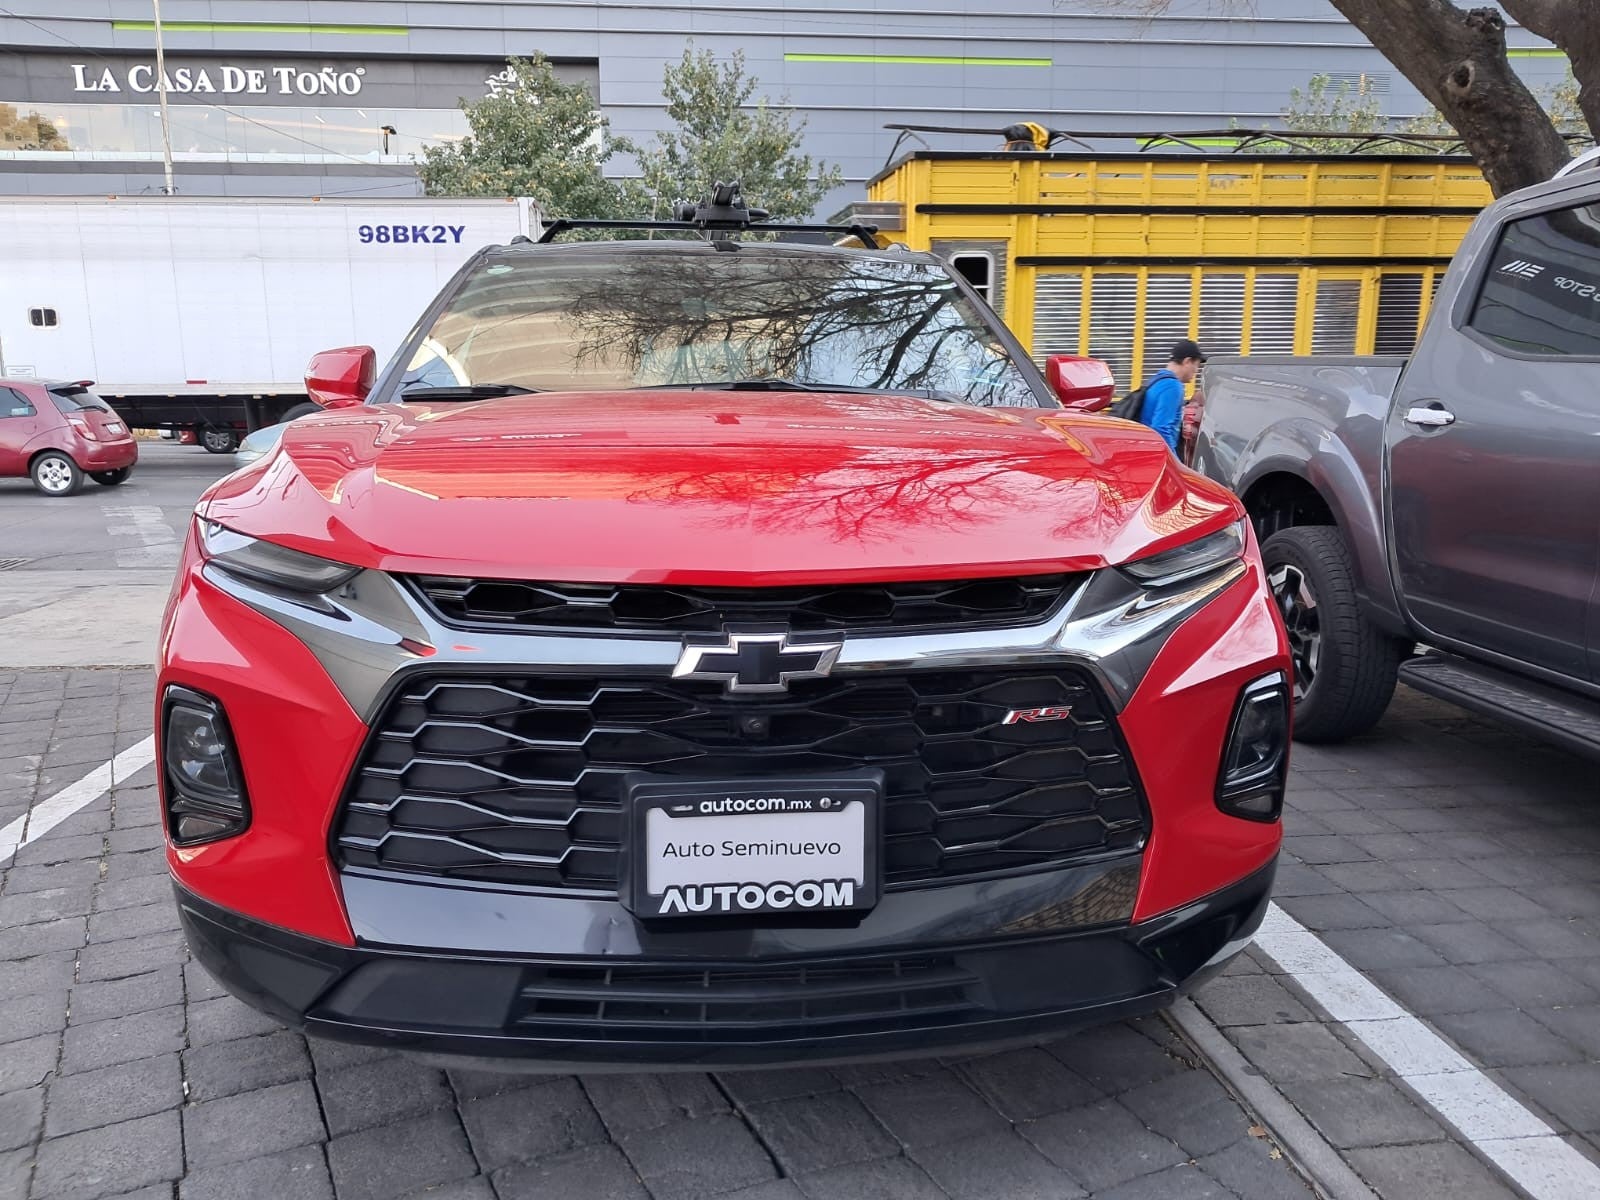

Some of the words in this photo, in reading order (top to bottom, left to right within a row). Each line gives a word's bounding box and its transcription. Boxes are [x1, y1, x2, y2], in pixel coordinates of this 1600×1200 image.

[71, 64, 120, 92] LA
[220, 66, 267, 93] DE
[358, 225, 466, 243] 98BK2Y
[1002, 706, 1073, 725] RS
[700, 797, 812, 813] autocom.mx
[662, 842, 716, 858] Auto
[721, 840, 841, 857] Seminuevo
[658, 882, 854, 914] AUTOCOM
